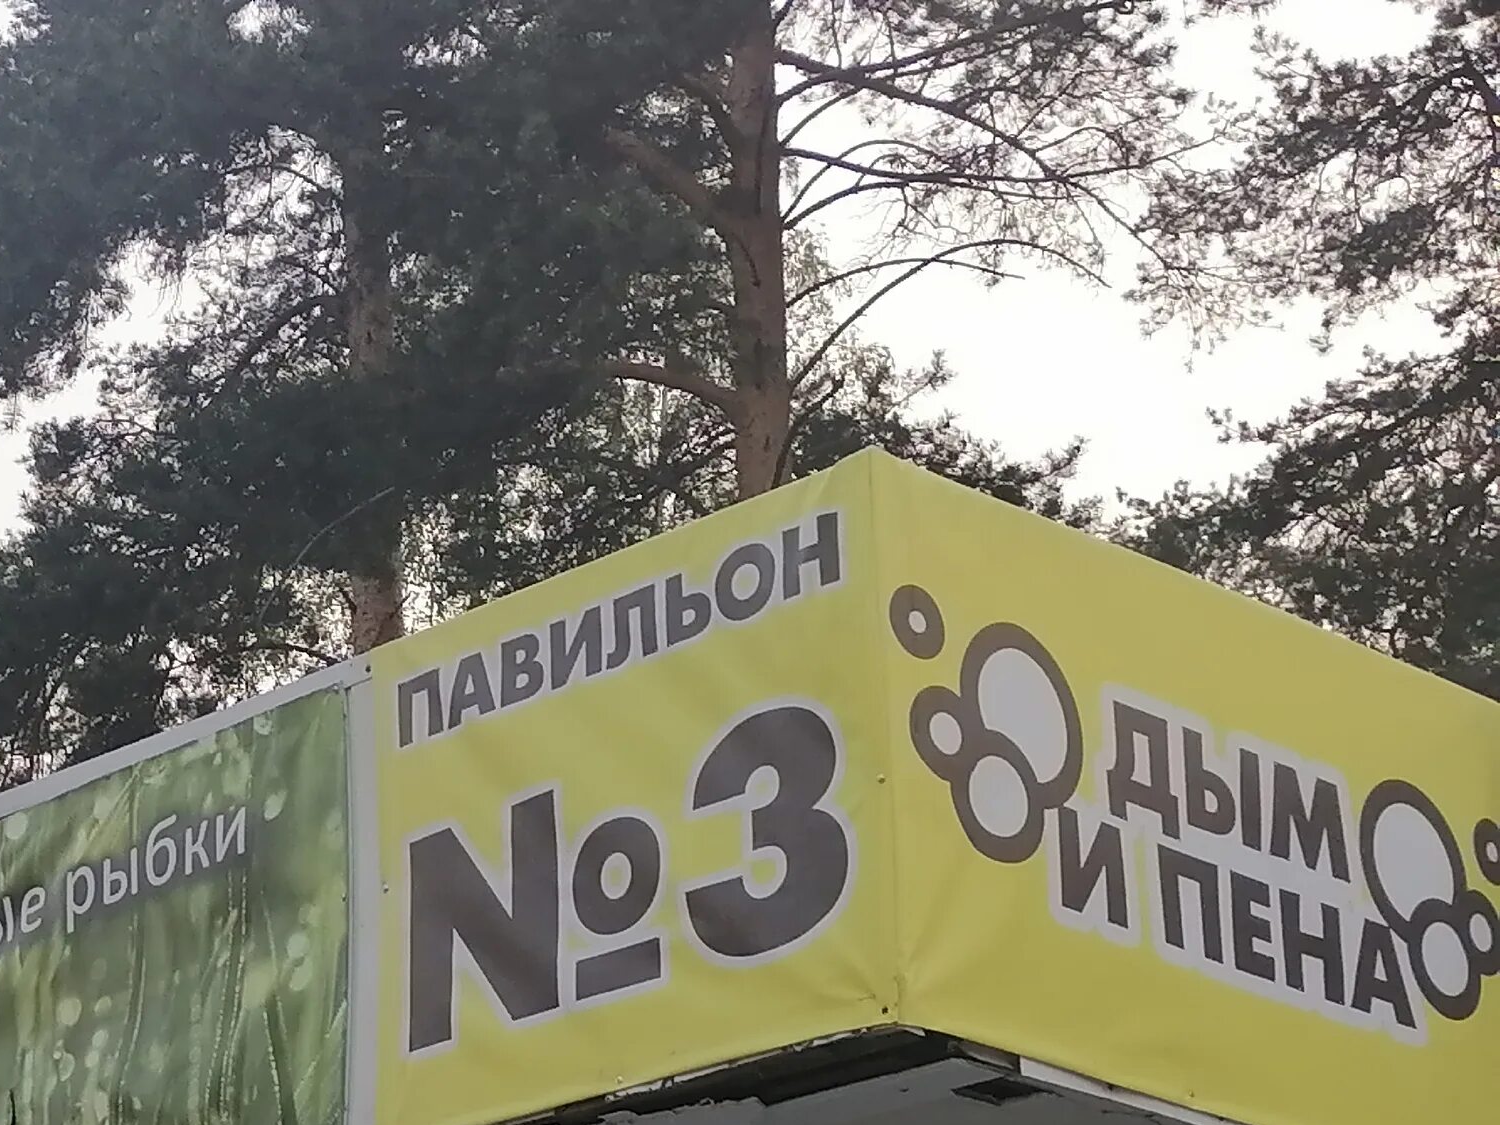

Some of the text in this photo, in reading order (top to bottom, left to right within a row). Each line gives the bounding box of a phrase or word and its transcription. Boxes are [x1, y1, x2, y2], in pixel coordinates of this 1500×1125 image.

[398, 512, 841, 748] ПАВИЛЬОН
[65, 806, 247, 932] рыбки
[1107, 700, 1351, 883] ДЫМ
[1058, 805, 1417, 1030] И ПЕНА
